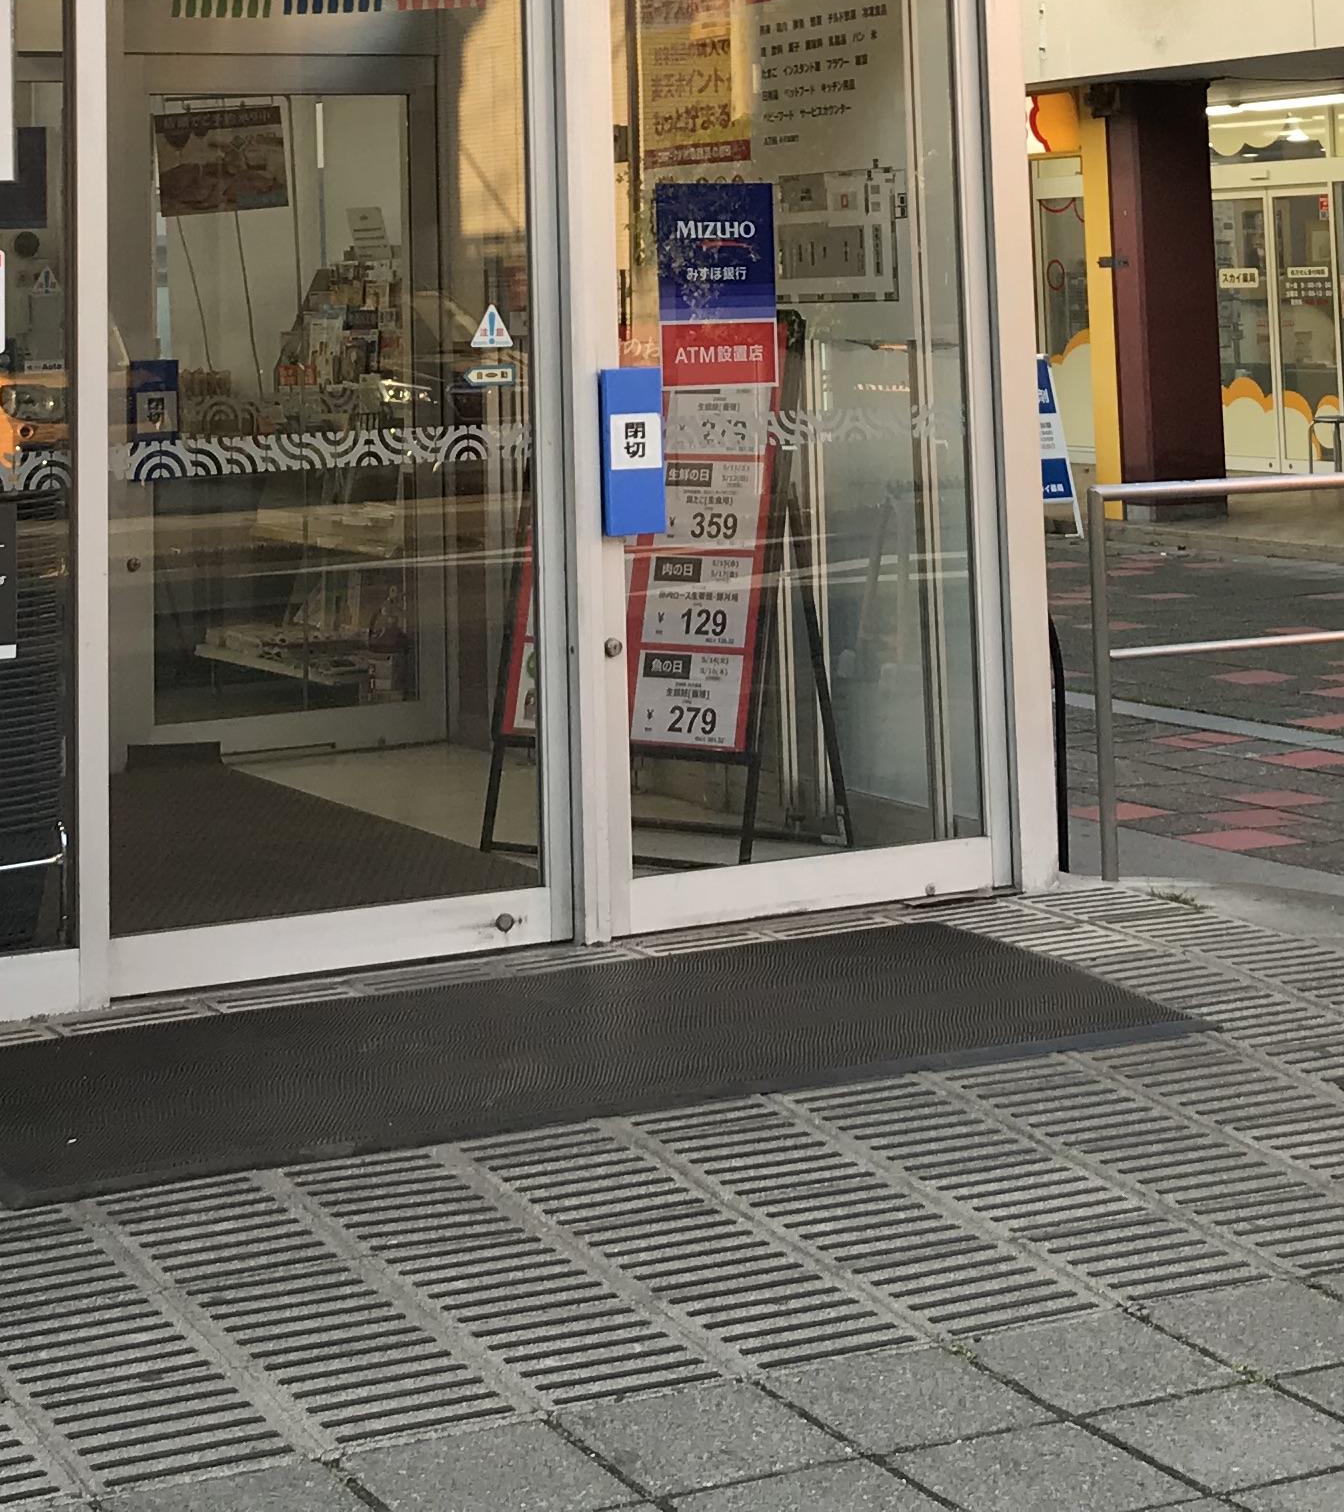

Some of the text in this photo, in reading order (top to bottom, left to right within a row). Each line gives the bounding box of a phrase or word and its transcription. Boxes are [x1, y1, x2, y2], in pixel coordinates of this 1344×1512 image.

[676, 220, 756, 240] MIZUHO
[686, 266, 747, 281] みずほ銀行
[674, 345, 764, 364] ATM設置店
[623, 421, 646, 459] 閉切
[668, 468, 710, 482] 生鮮の日
[690, 512, 738, 539] 359
[661, 562, 694, 577] 肉の日
[658, 607, 727, 637] ¥ 129
[651, 658, 683, 673] 魚の日
[646, 705, 717, 735] ¥ 279
